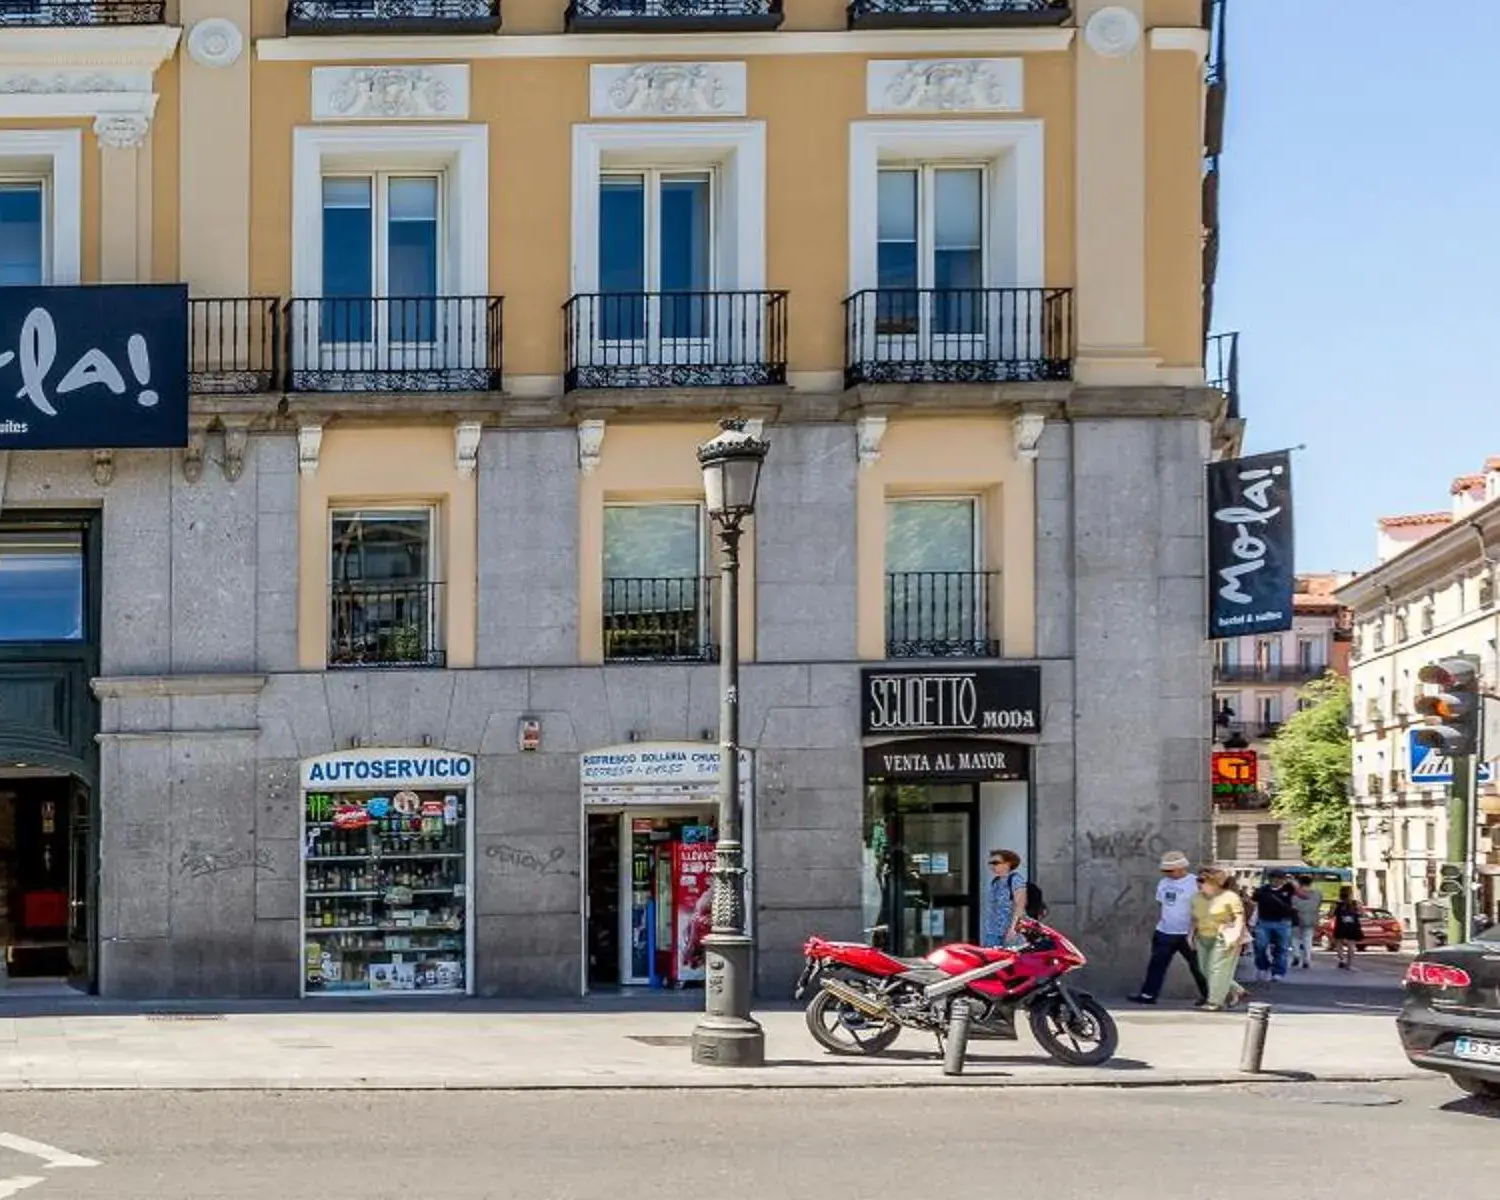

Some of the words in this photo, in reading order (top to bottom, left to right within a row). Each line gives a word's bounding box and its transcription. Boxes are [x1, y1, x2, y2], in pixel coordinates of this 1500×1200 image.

[870, 676, 977, 728] SCUDETTO
[983, 710, 1035, 728] MODA
[309, 757, 471, 781] AUTOSERVICIO
[883, 755, 930, 771] VENTA
[935, 754, 955, 770] AL
[958, 752, 1007, 769] MAYOR
